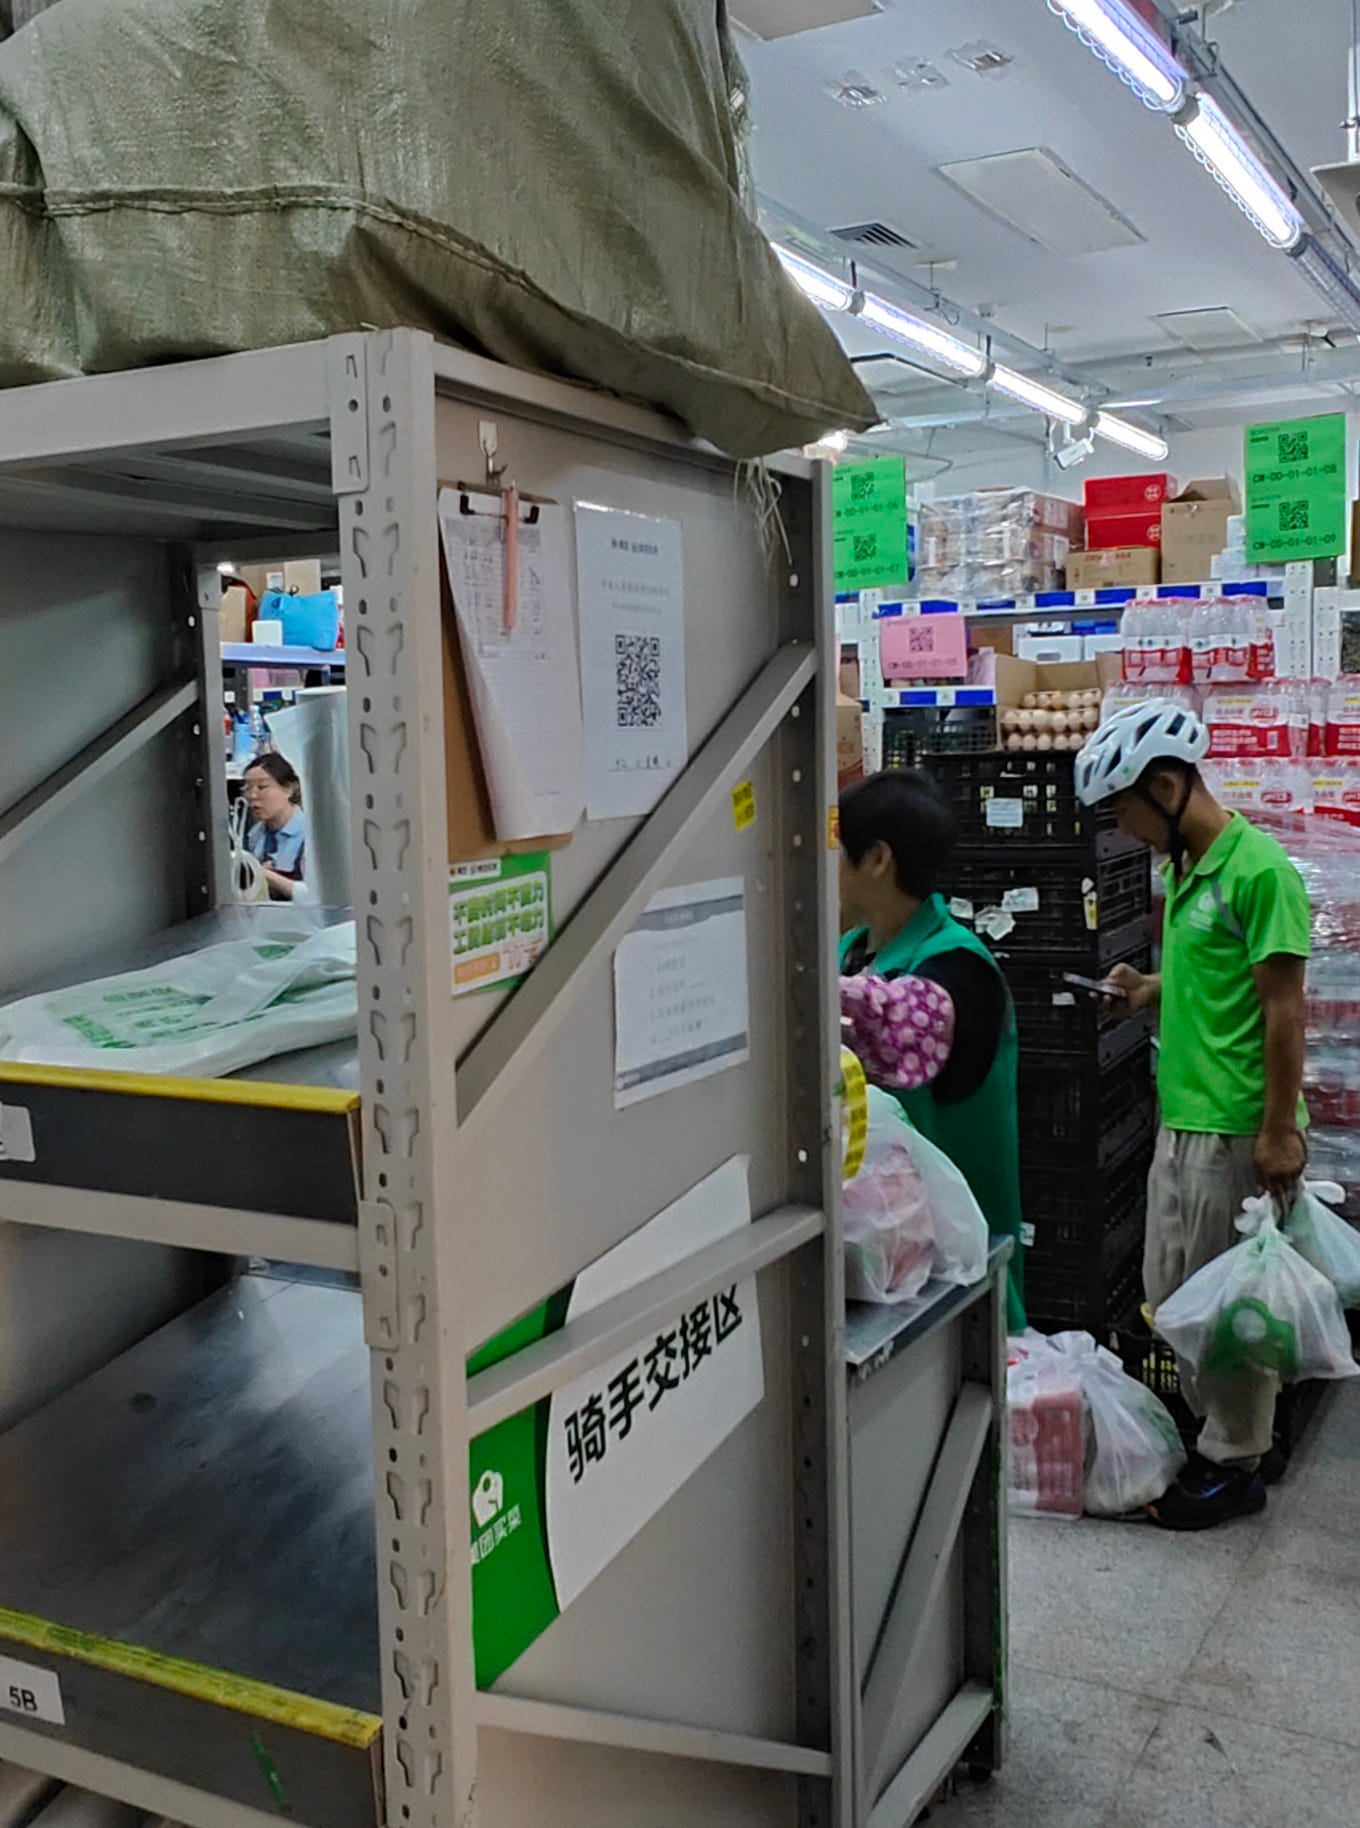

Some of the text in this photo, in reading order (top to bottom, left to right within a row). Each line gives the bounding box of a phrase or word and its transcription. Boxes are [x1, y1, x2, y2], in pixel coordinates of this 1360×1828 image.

[564, 1284, 743, 1485] 骑手交接区
[9, 1685, 37, 1712] 5B
